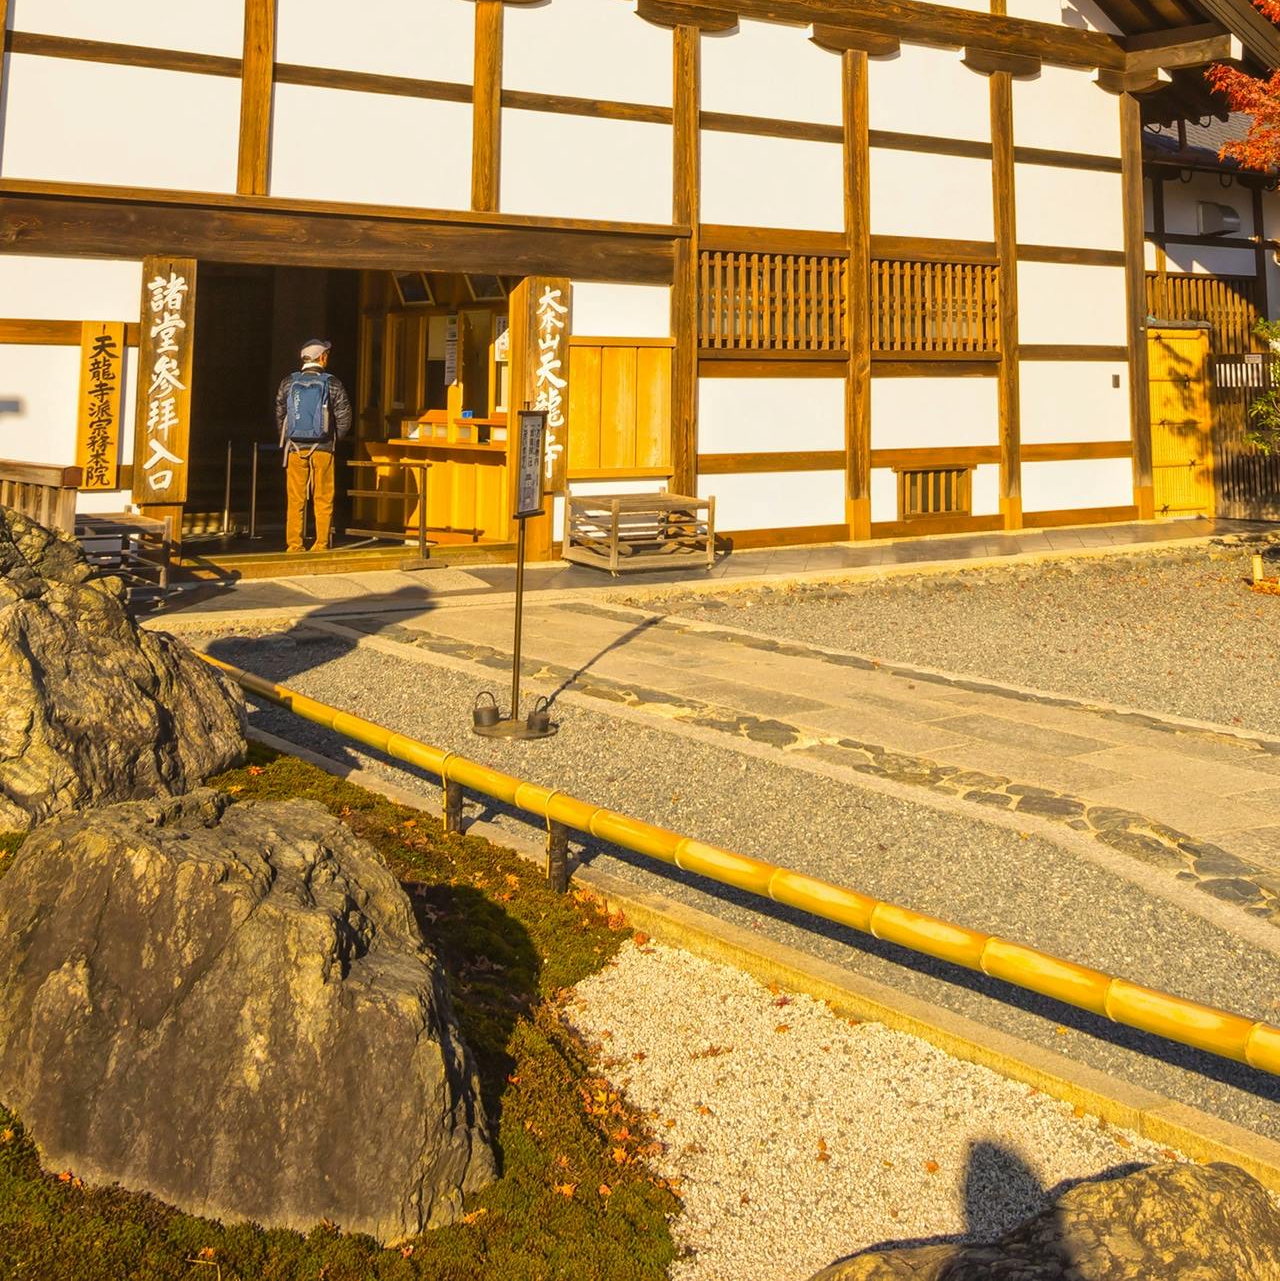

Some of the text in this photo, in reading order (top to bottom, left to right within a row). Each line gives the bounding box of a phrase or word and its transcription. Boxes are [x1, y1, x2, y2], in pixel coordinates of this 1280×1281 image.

[86, 335, 120, 488] 天龍寺派宗務本院
